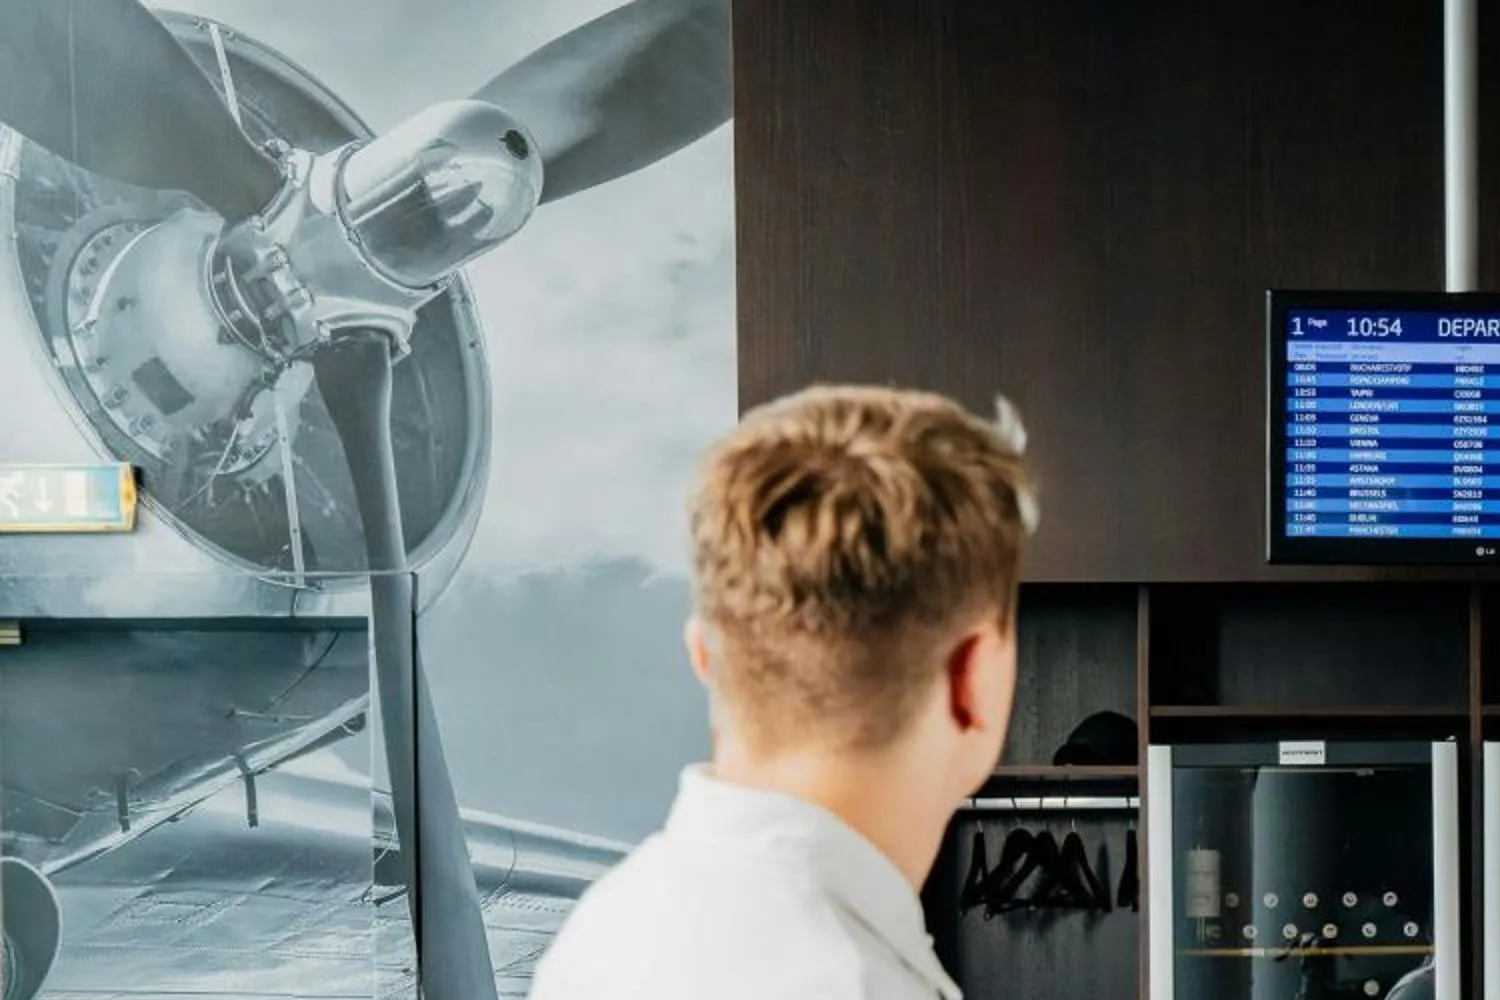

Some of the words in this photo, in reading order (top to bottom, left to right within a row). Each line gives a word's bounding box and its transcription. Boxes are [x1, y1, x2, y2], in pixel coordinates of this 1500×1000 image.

[1292, 317, 1304, 335] 1
[1307, 317, 1328, 328] Page
[1347, 317, 1402, 336] 10:54
